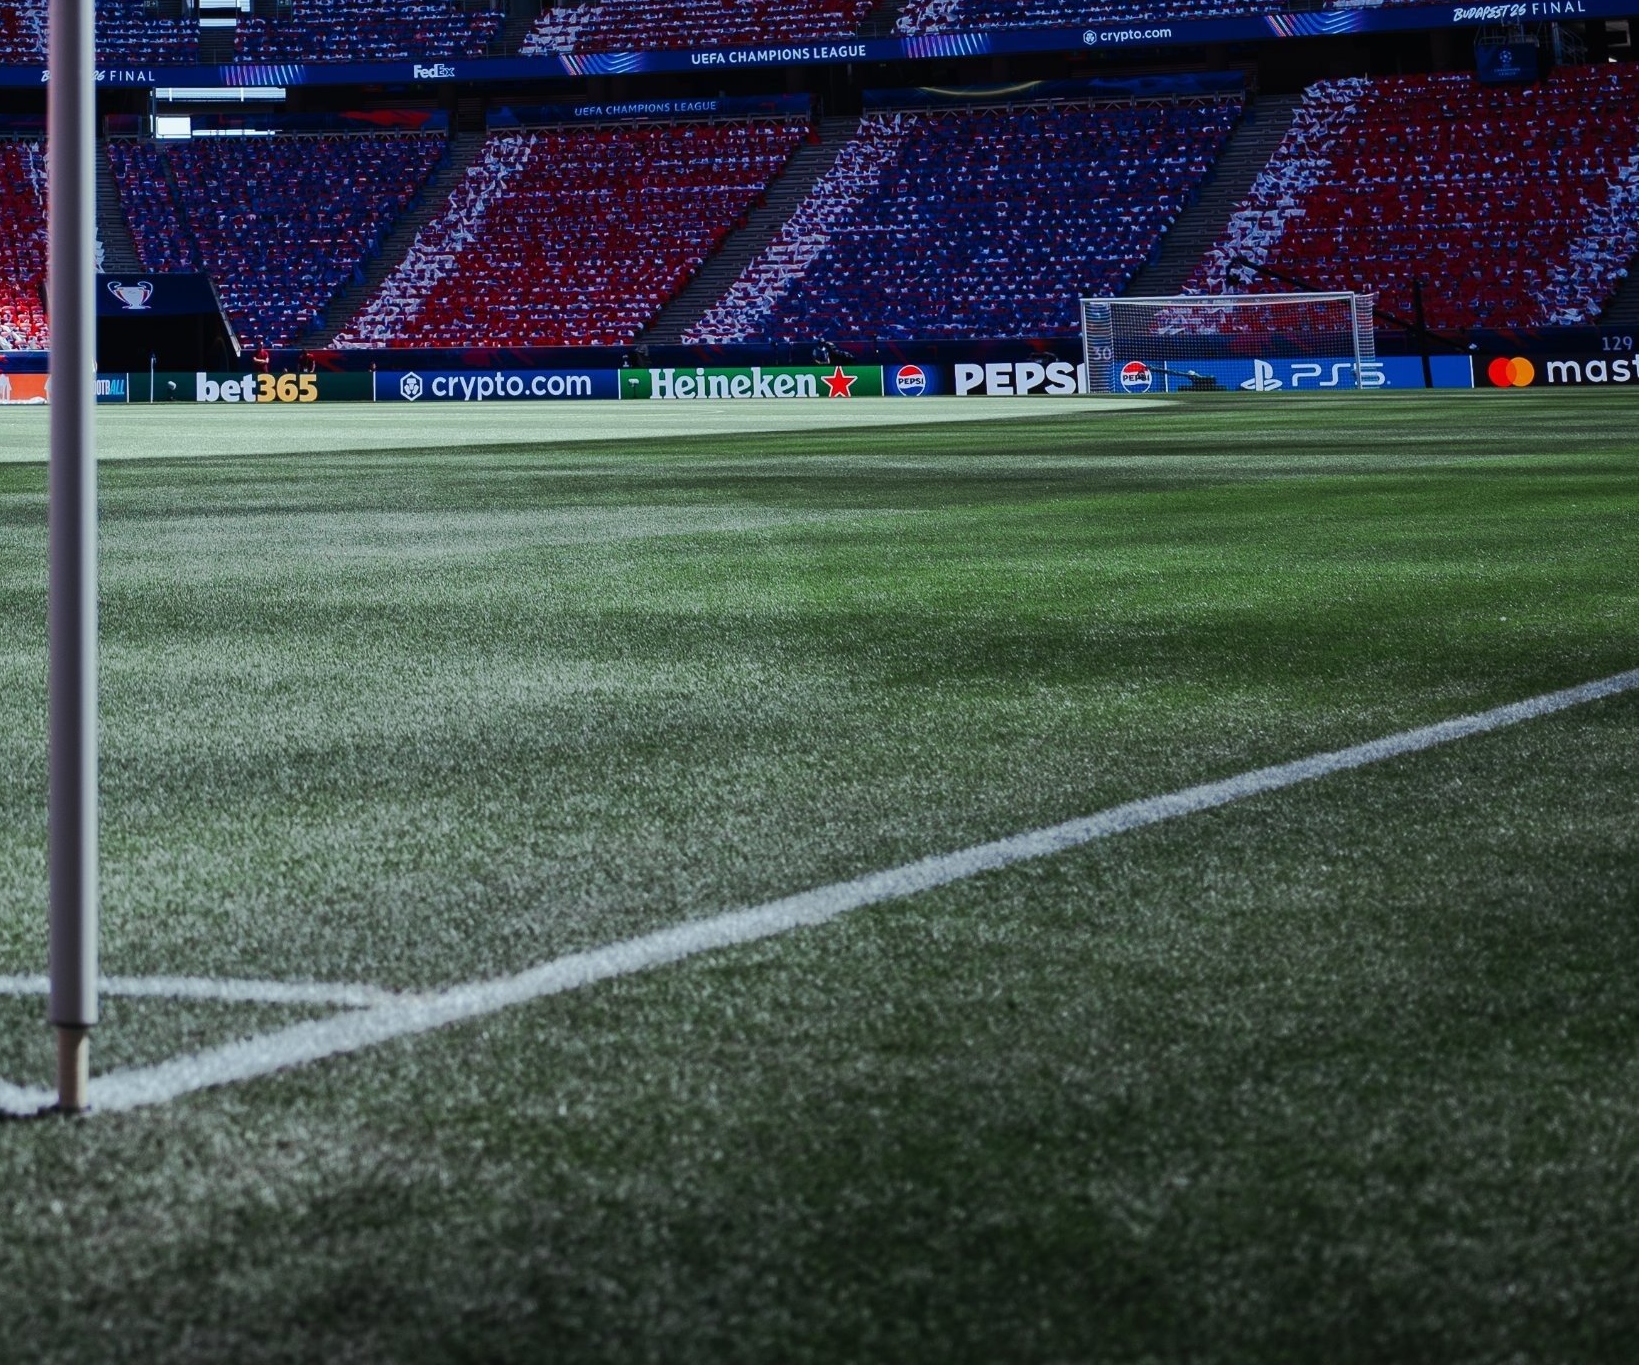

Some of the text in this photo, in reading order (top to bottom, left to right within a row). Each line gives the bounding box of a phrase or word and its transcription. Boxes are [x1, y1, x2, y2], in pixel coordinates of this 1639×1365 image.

[1453, 5, 1511, 22] BUDAPEST
[1532, 0, 1586, 15] FINAL
[1100, 28, 1172, 43] crypto.com
[691, 44, 867, 65] UEFA CHAMPIONS LEAGUE
[110, 71, 155, 81] FINAL
[413, 63, 455, 79] FedEx
[574, 100, 717, 117] UEFA CHAMPIONS LEAGUE
[1602, 336, 1632, 351] 129
[649, 366, 820, 399] Heineken
[898, 376, 925, 386] PEPSI
[954, 362, 1087, 395] PEPSI
[1291, 362, 1386, 387] PS5
[196, 372, 318, 403] bet365
[432, 373, 592, 401] crypto.com
